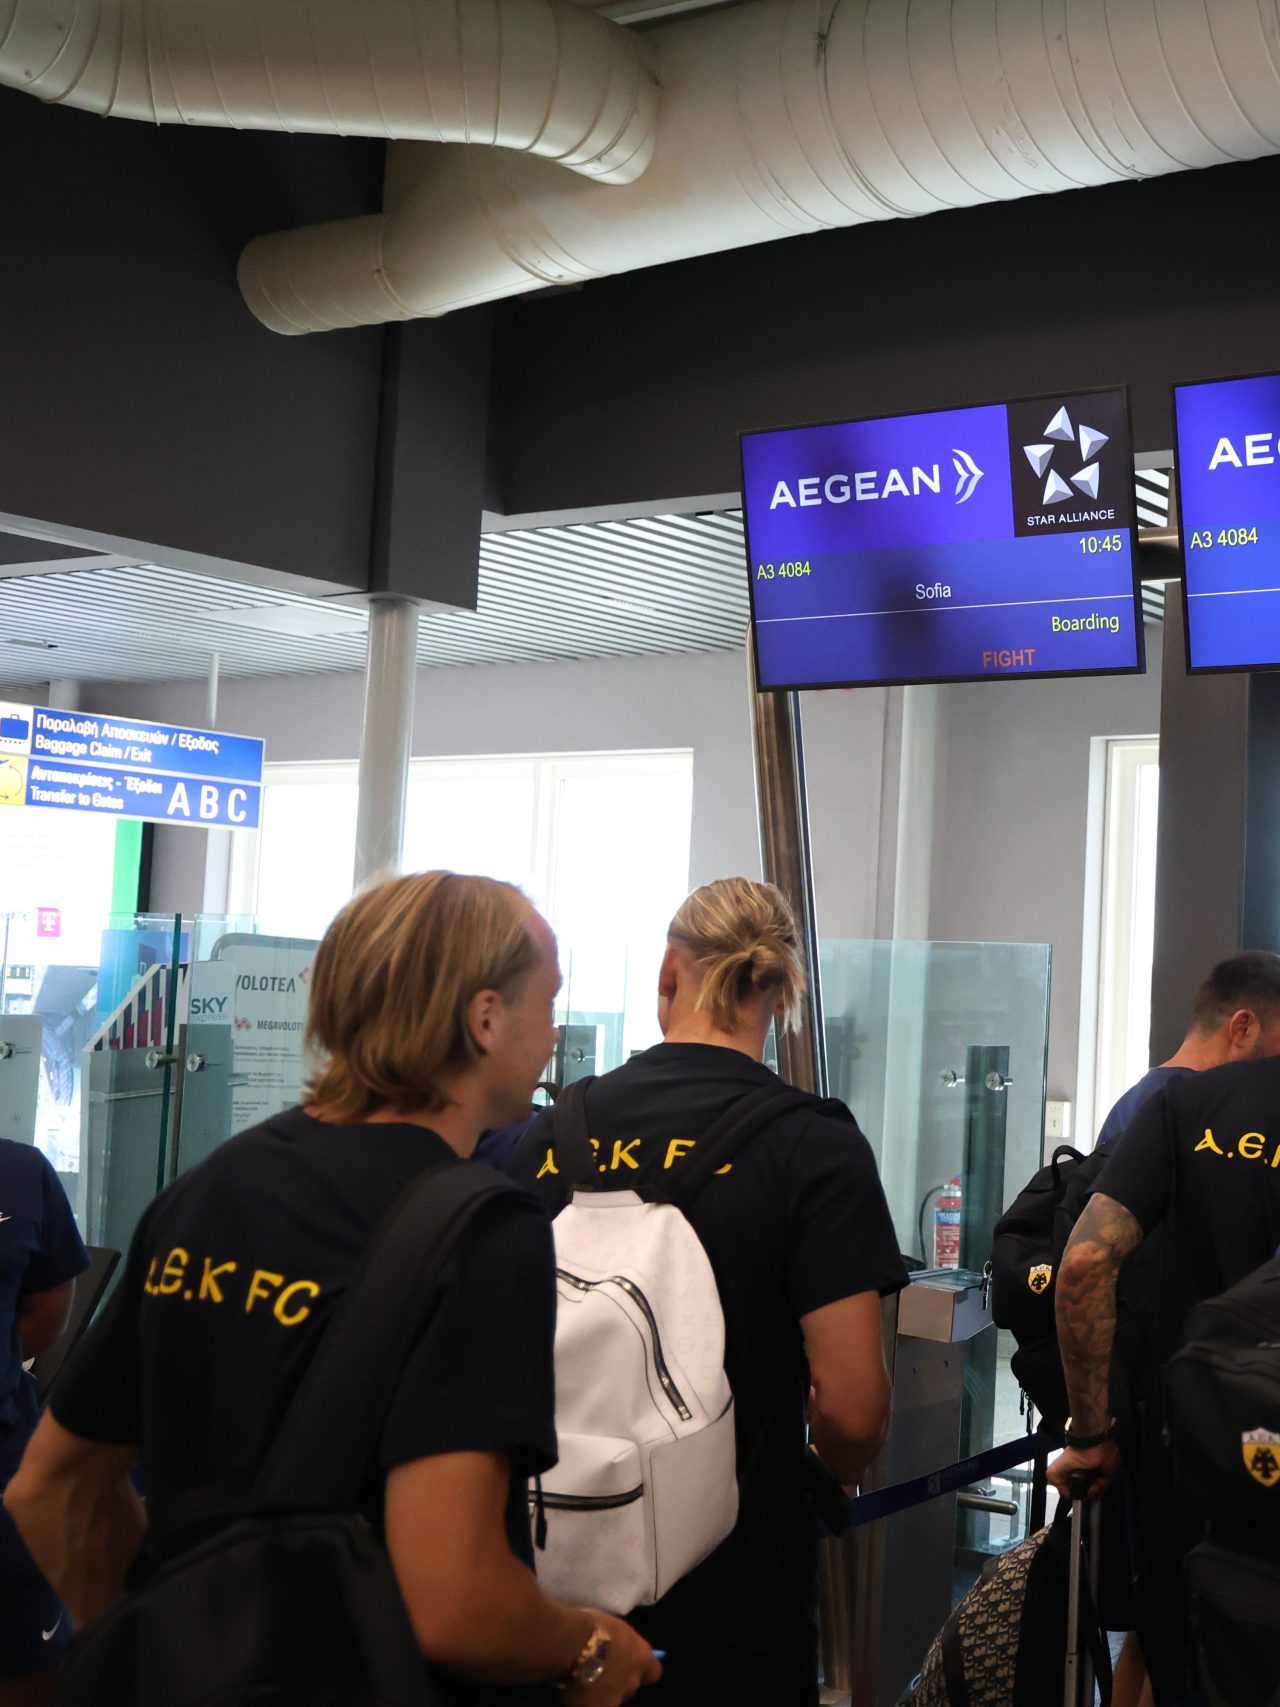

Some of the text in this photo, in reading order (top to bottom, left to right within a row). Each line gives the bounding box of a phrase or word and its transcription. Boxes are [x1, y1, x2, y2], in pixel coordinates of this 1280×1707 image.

[769, 464, 941, 510] AEGEAN
[1026, 510, 1115, 527] STAR ALLIANCE
[1079, 535, 1122, 554] 10:45
[1190, 528, 1259, 549] A3 4084
[757, 561, 811, 580] A3 4084
[915, 583, 951, 599] Sofia
[1051, 613, 1120, 632] Boarding
[982, 649, 1035, 667] FIGHT
[35, 734, 88, 757] Baggage
[90, 741, 122, 759] Claim
[131, 745, 152, 763] Exit
[30, 786, 76, 804] Transfer
[78, 793, 91, 806] to
[200, 785, 219, 819] B
[227, 788, 248, 823] C
[191, 996, 228, 1014] SKY
[245, 1279, 321, 1327] FC
